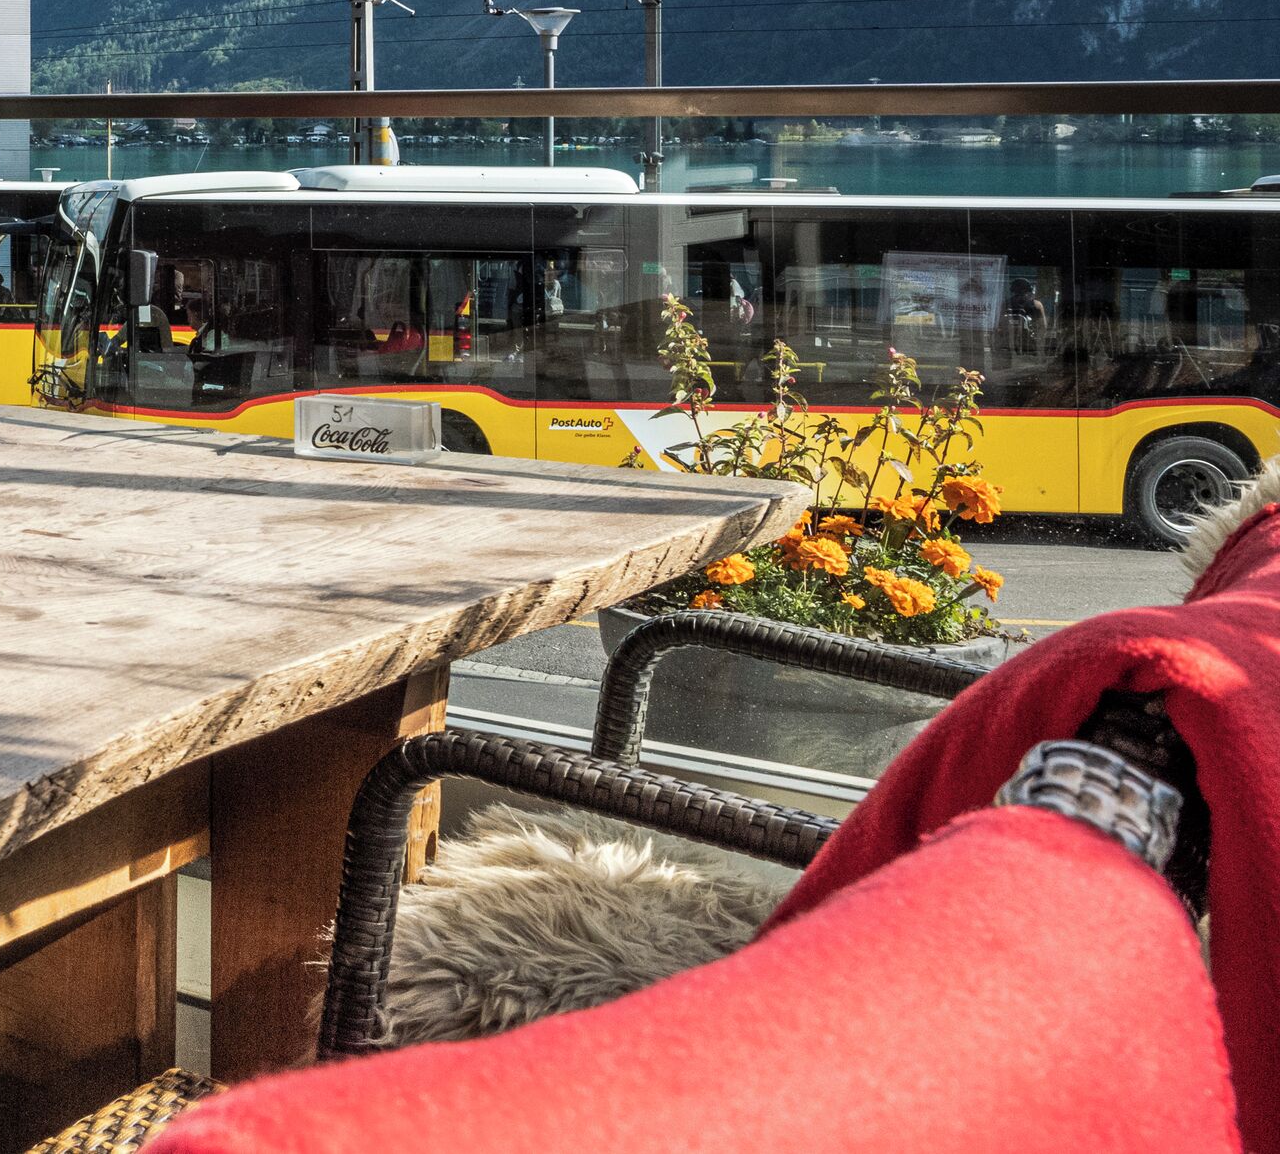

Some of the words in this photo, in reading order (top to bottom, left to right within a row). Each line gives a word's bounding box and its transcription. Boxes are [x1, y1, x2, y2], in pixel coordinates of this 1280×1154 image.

[331, 405, 354, 423] 51
[551, 418, 602, 428] PostAuto
[312, 423, 393, 454] Coca-Cola
